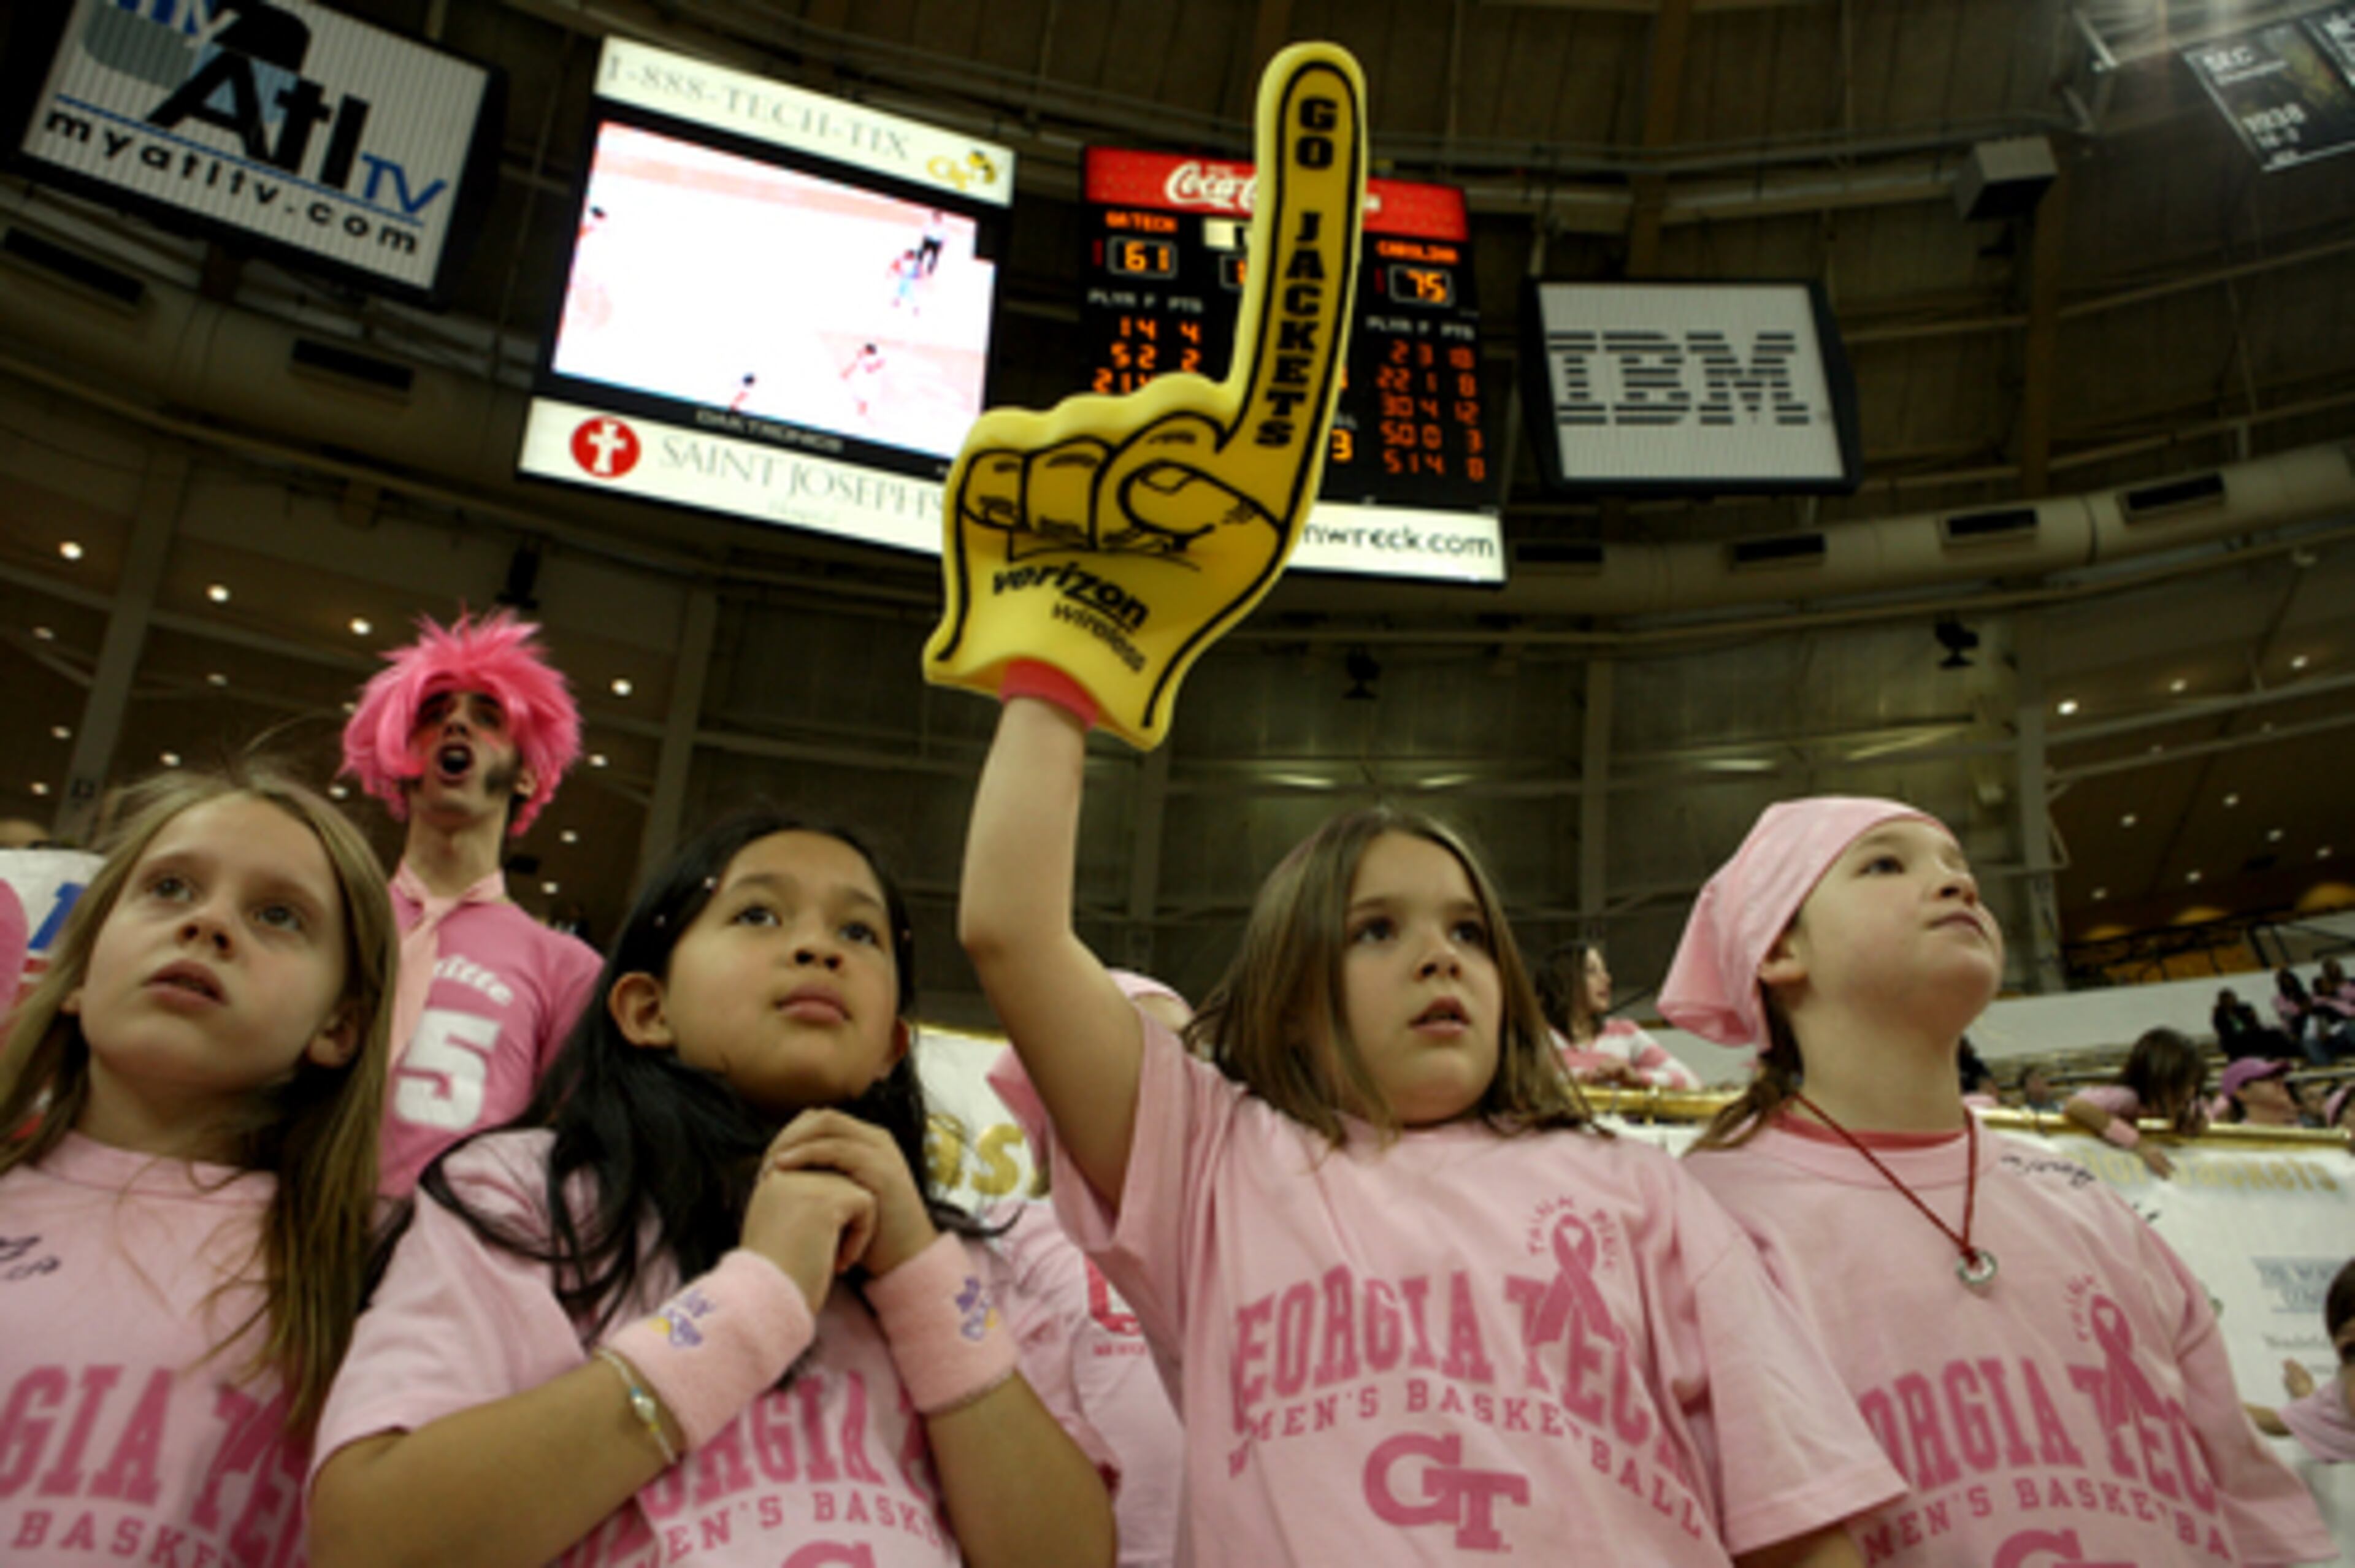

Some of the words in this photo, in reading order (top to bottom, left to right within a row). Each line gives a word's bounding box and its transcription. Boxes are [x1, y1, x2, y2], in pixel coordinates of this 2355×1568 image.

[1295, 97, 1338, 171] GO
[1254, 212, 1326, 448] JACKETS
[1547, 330, 1810, 426] IBM
[659, 434, 778, 489] SAINT
[992, 562, 1151, 632] verizon
[1363, 1432, 1531, 1551] GT
